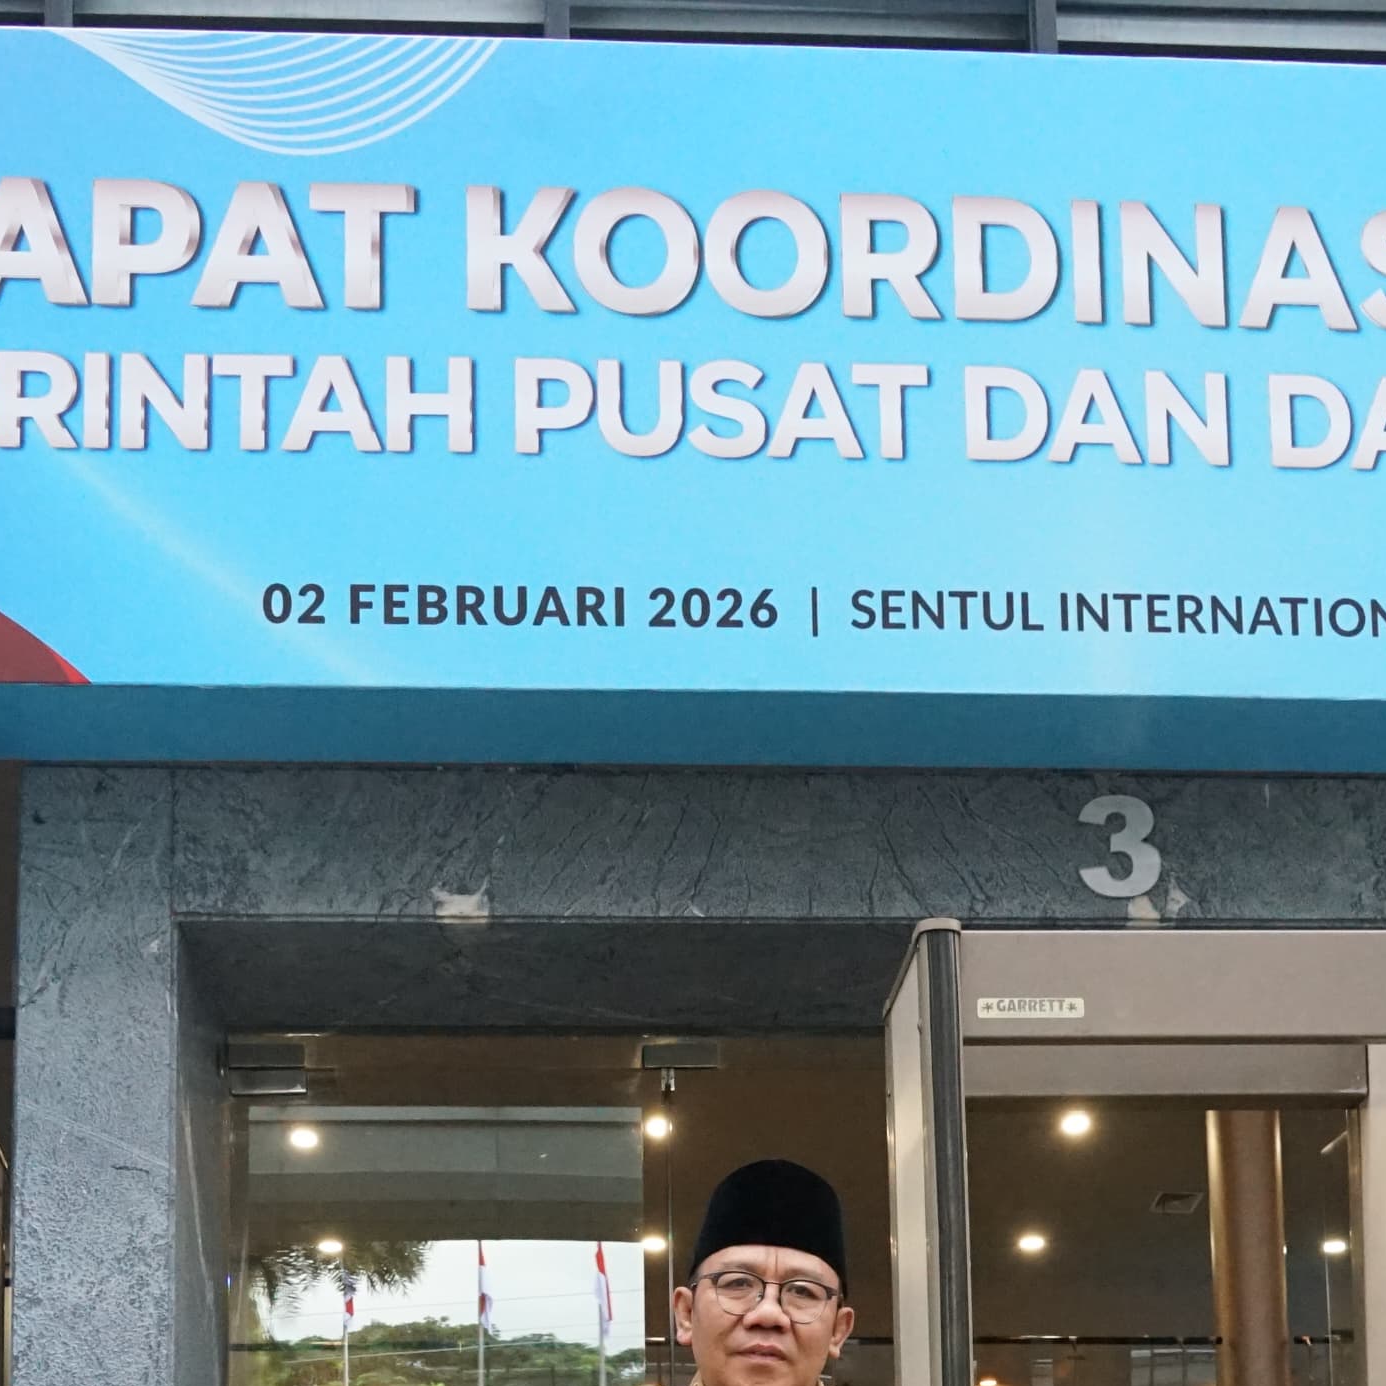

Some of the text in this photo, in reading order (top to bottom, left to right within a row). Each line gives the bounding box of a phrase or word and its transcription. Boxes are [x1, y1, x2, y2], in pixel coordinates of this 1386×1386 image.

[514, 356, 930, 460] PUSAT
[963, 366, 1230, 468] DAN
[263, 582, 326, 625] 02
[349, 583, 626, 628] FEBRUARI
[647, 587, 779, 629] 2026
[850, 588, 1044, 633] SENTUL
[1077, 794, 1162, 898] 3
[996, 999, 1067, 1013] GARRETT
